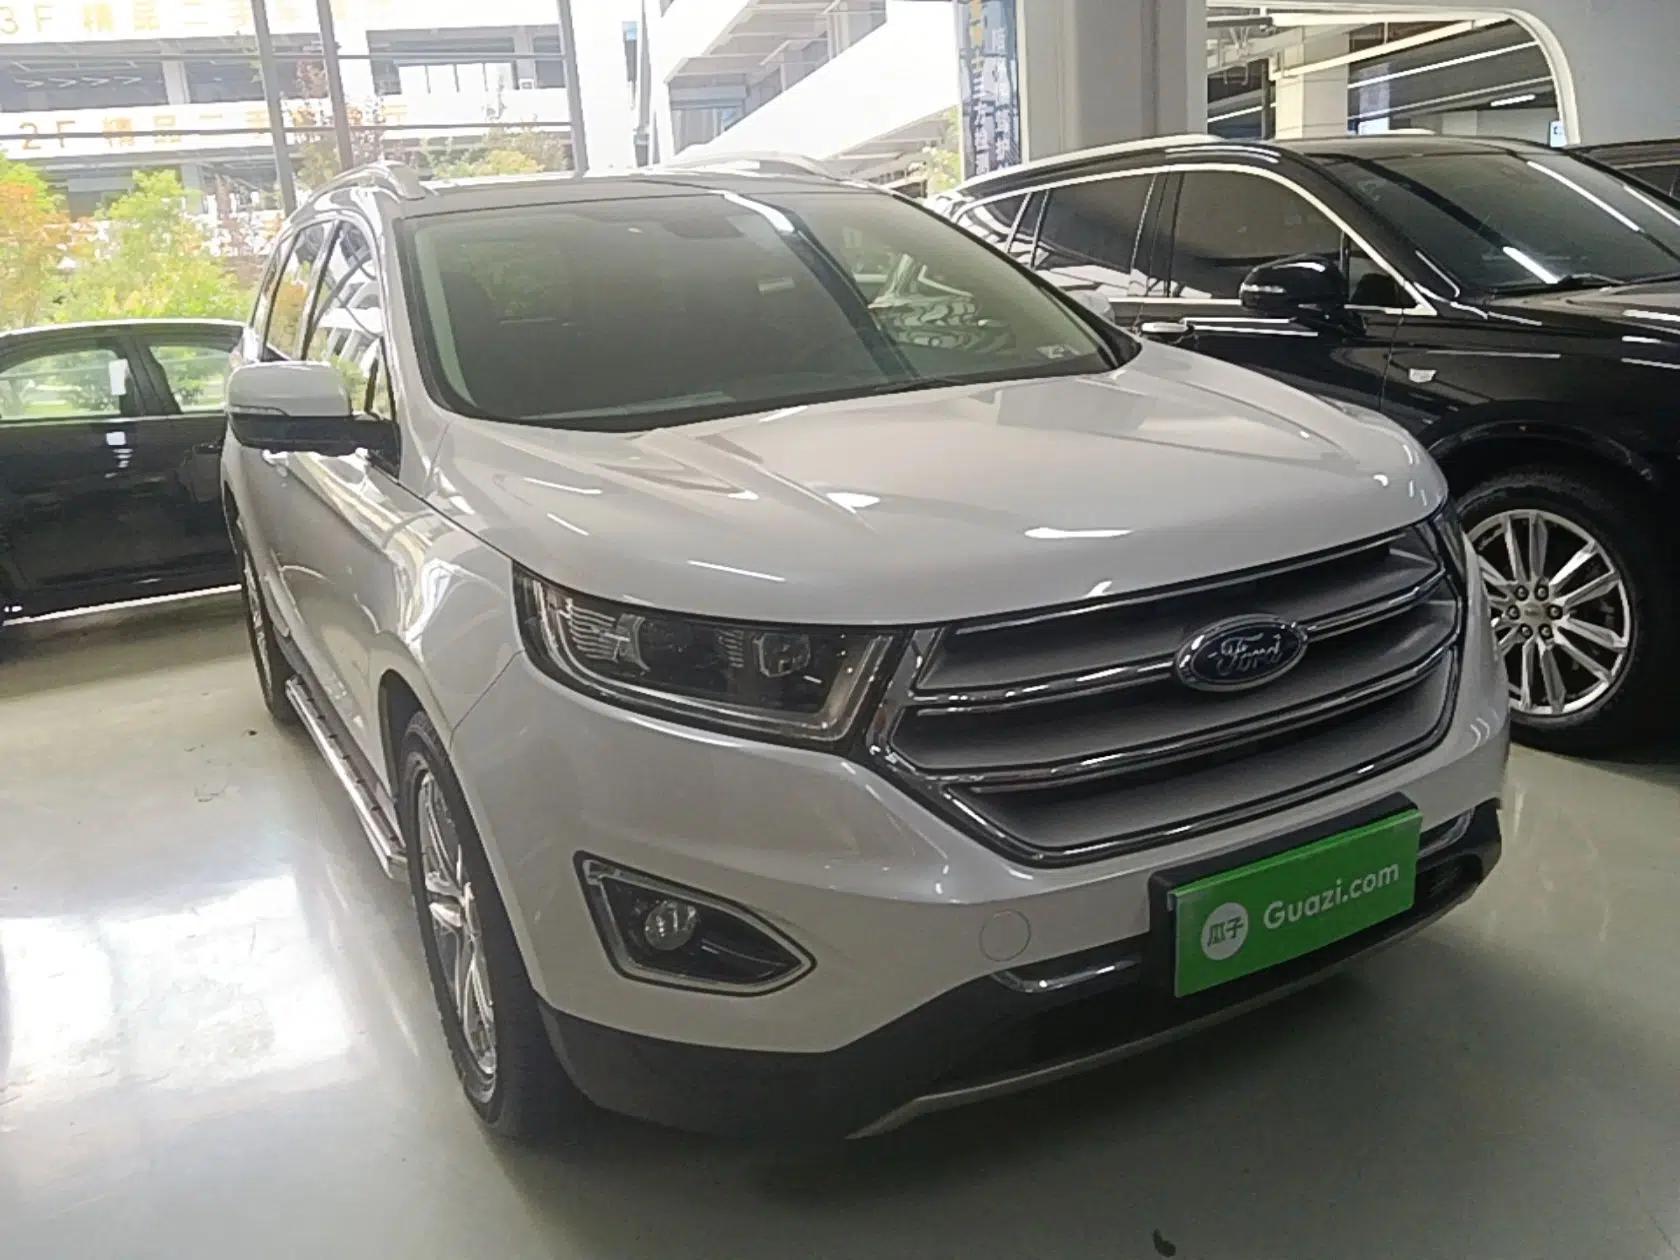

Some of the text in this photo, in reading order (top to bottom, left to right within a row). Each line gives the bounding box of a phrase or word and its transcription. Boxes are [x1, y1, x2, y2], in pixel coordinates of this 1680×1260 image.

[1208, 632, 1282, 677] Ford
[1207, 863, 1400, 948] 瓜子 Guazi.com
